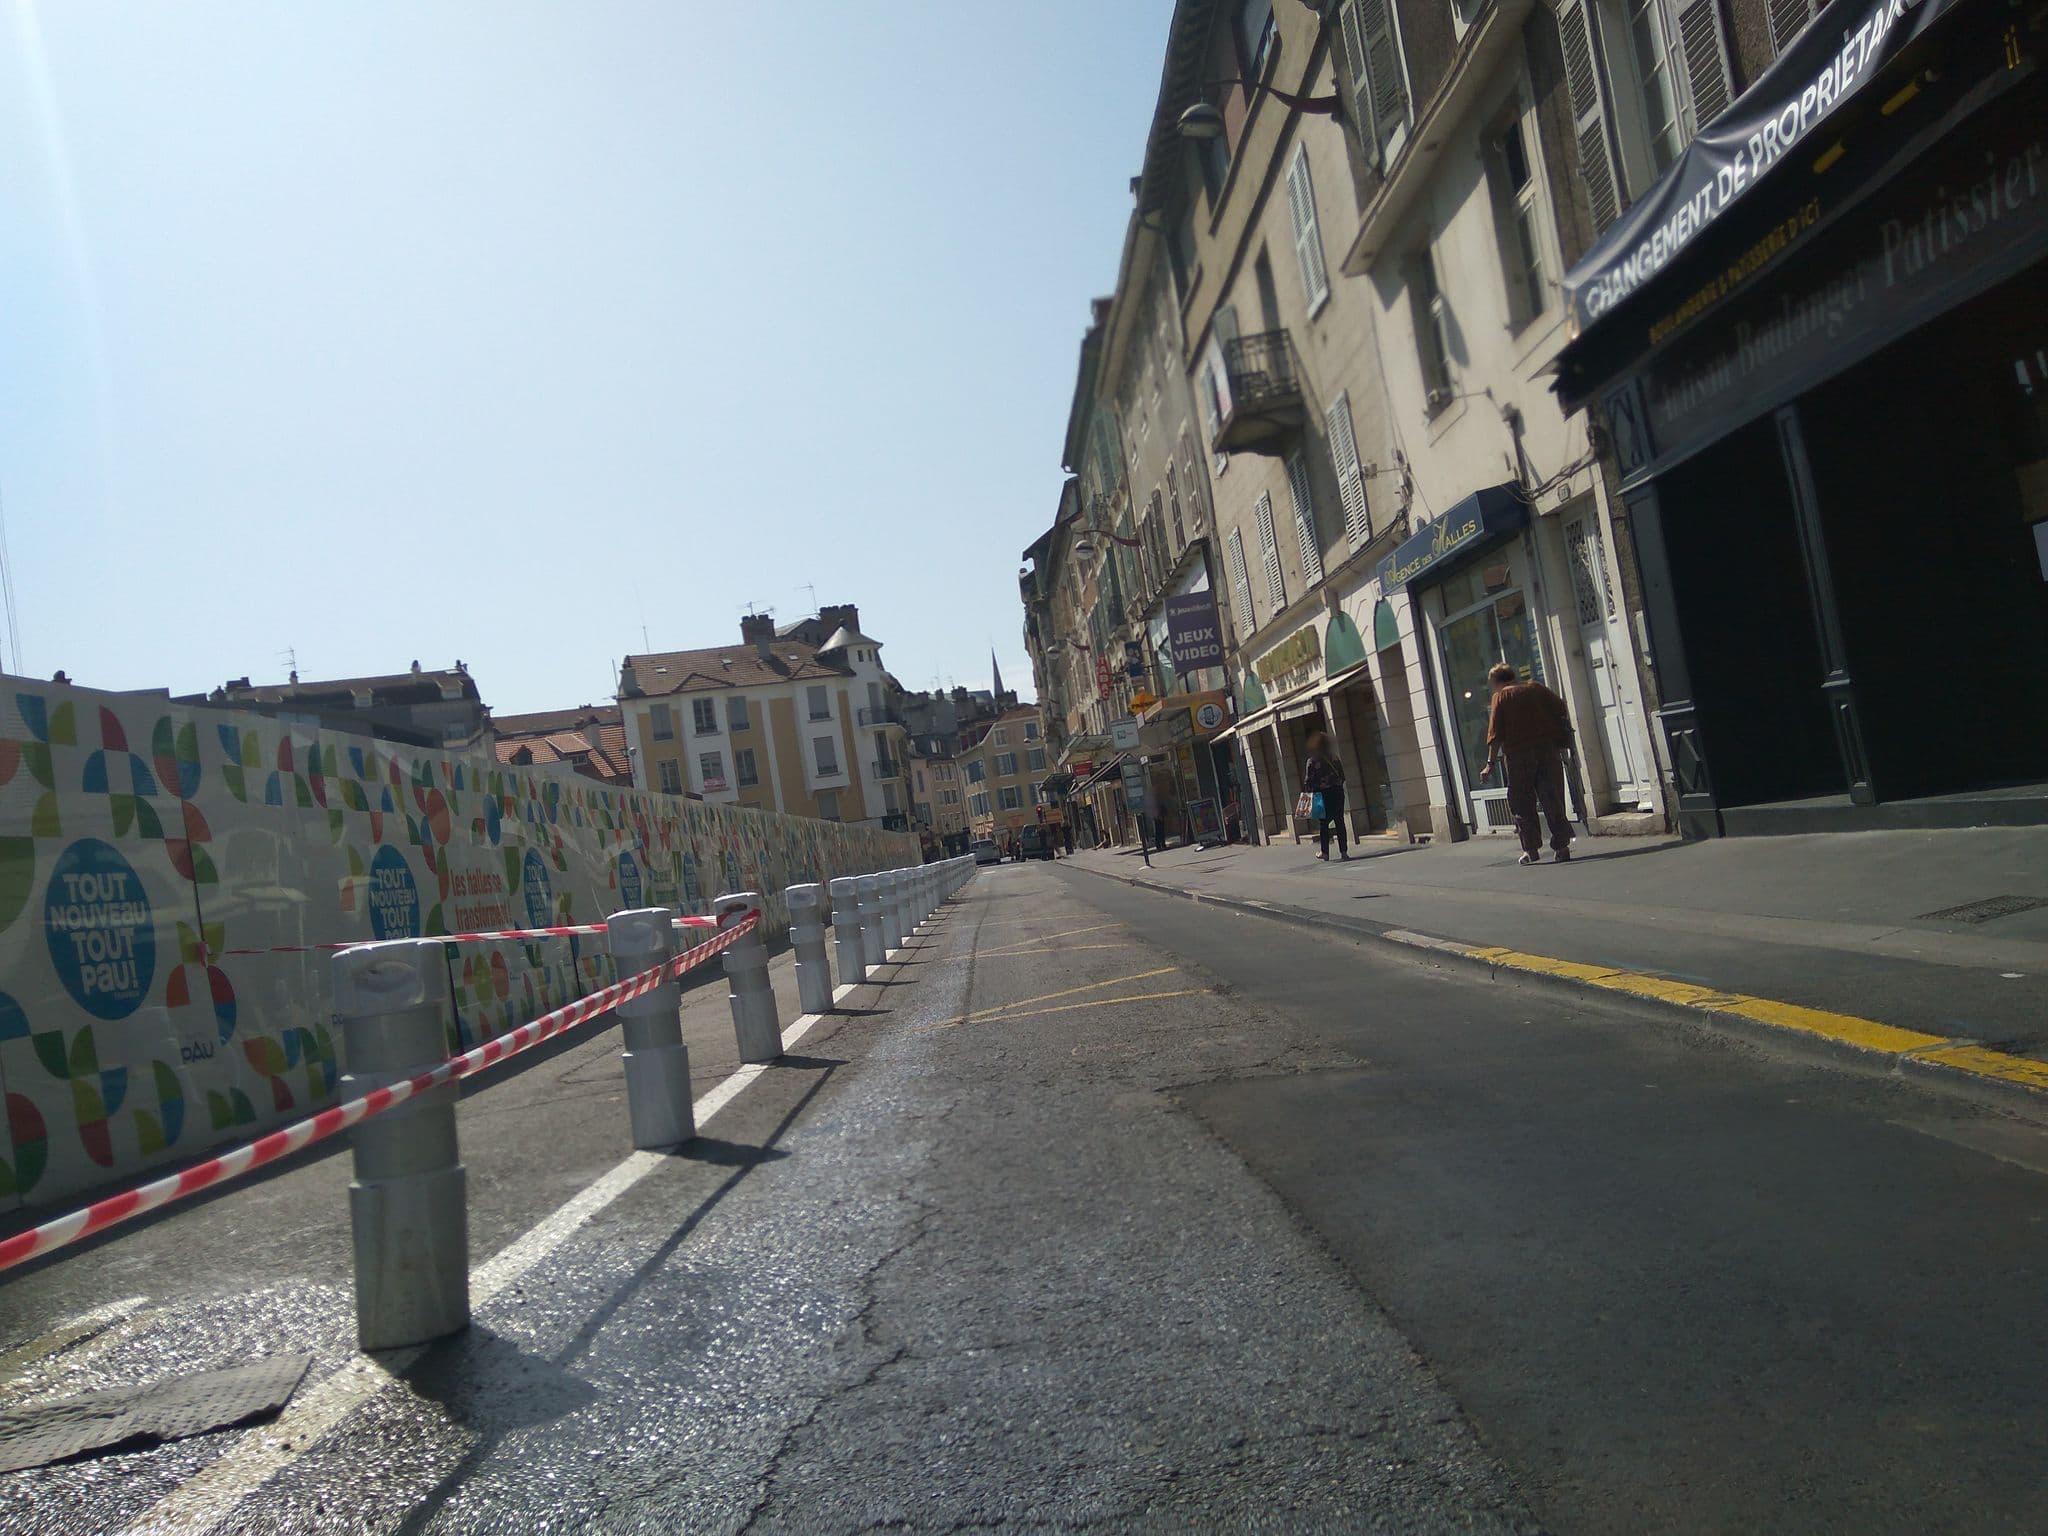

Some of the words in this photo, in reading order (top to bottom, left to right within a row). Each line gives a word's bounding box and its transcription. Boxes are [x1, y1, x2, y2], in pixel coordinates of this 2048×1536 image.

[1585, 180, 1716, 318] CHANGEMENT
[1717, 150, 1746, 209] DE
[1432, 516, 1476, 557] HALLES
[1175, 627, 1215, 646] JEUX
[1174, 644, 1220, 662] VIDEO
[1098, 656, 1110, 699] TABAC
[62, 872, 128, 903] TOUT
[376, 868, 408, 890] TOUT
[380, 906, 410, 929] TOUT
[70, 928, 134, 964] TOUT
